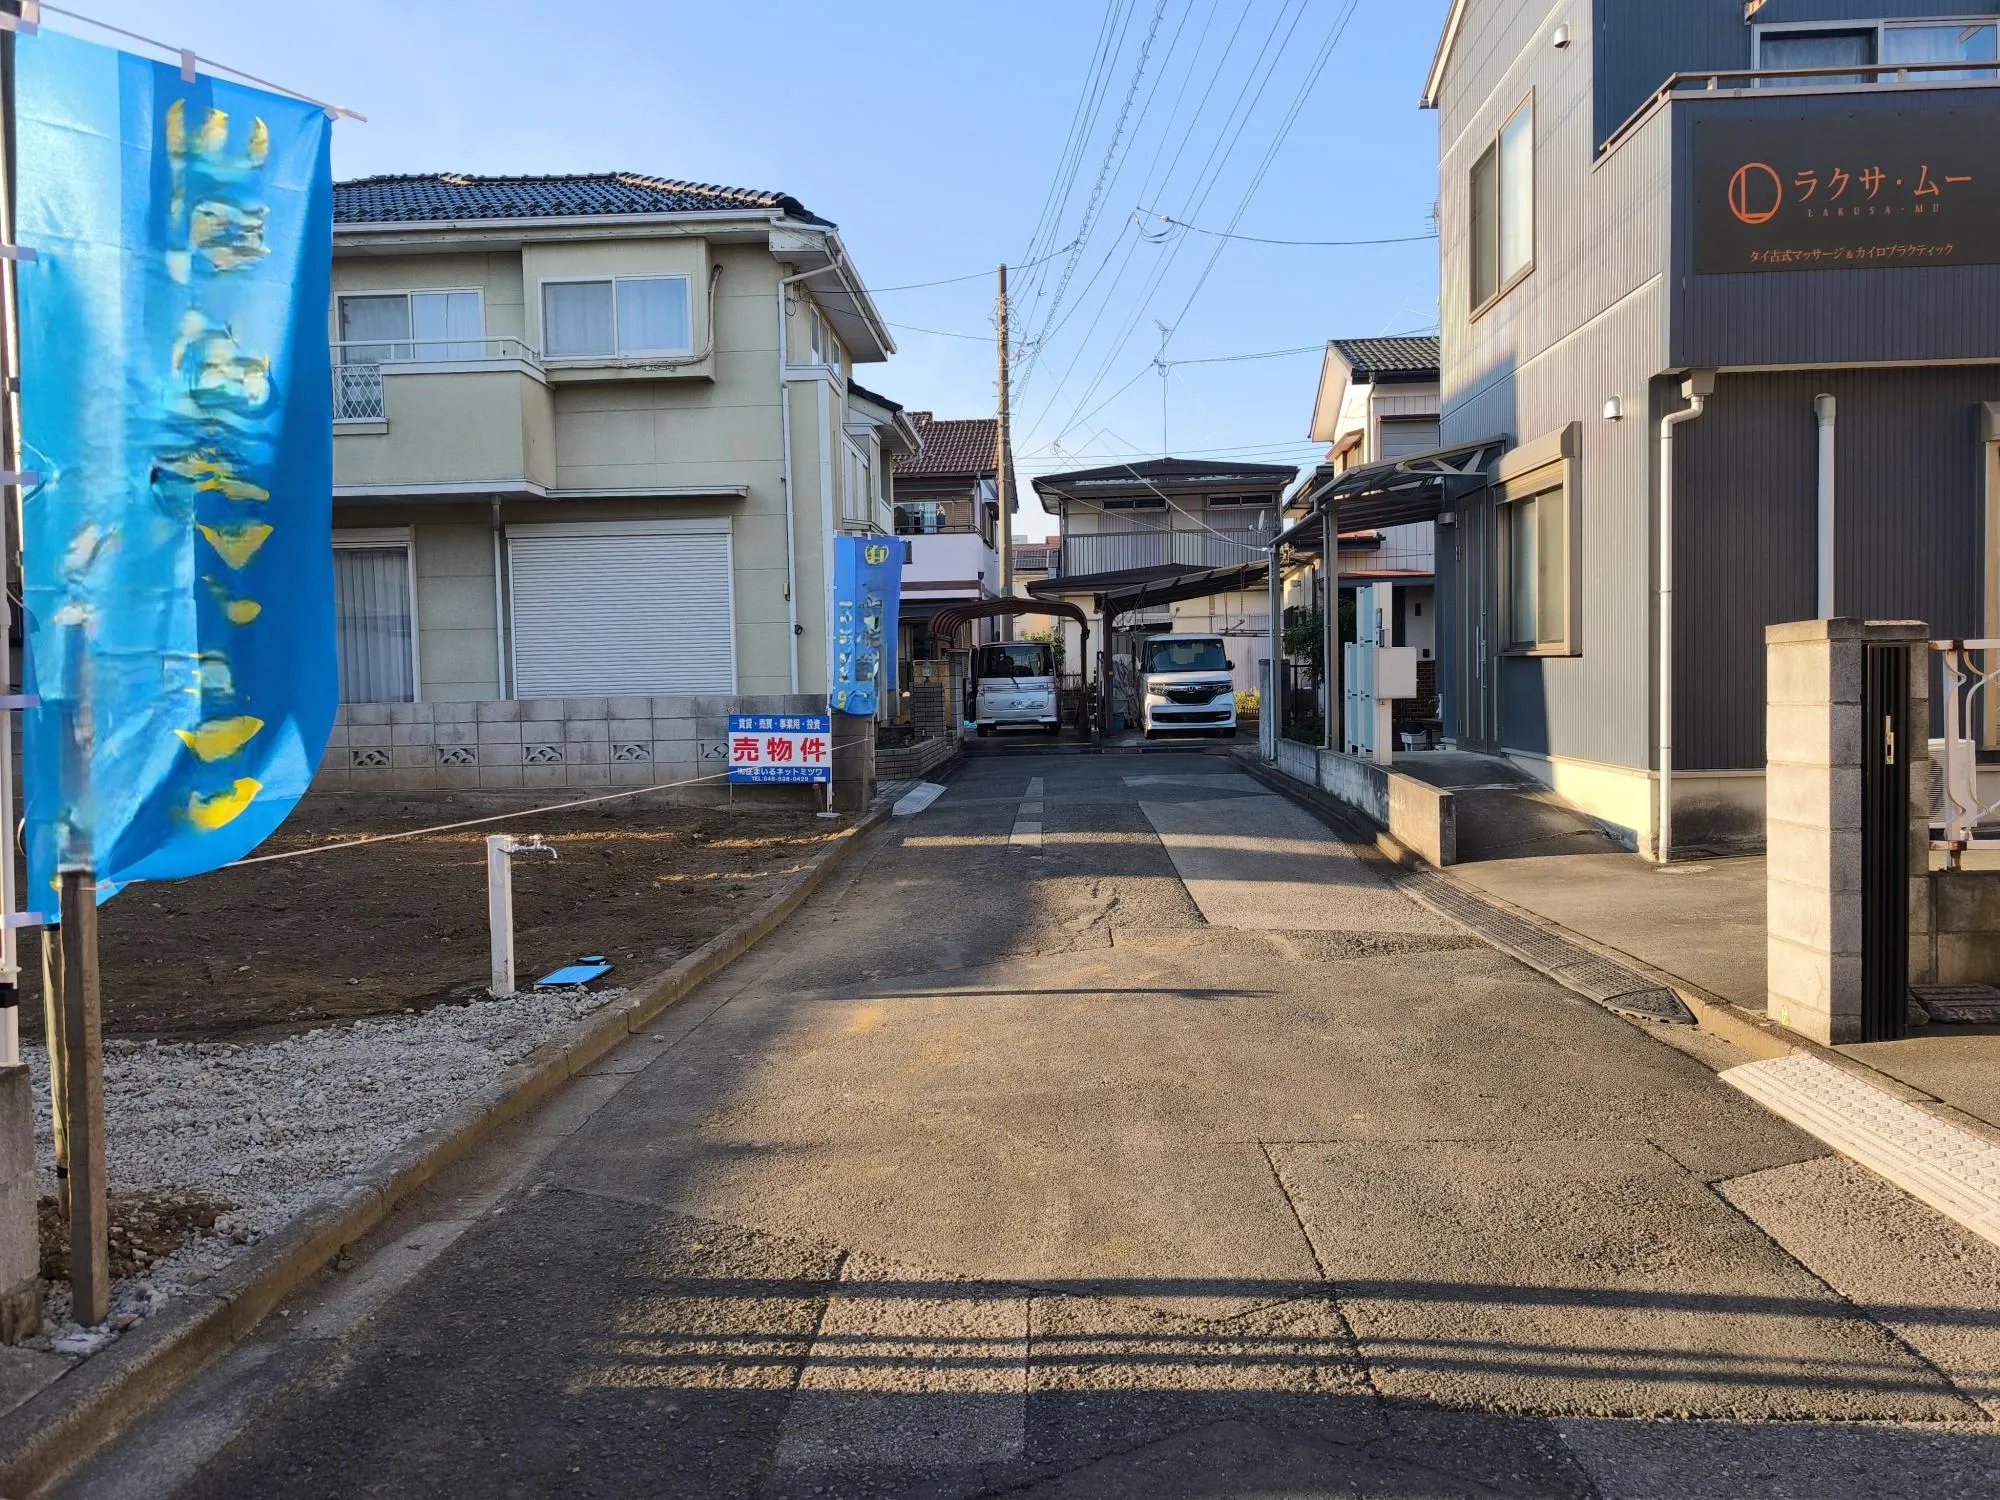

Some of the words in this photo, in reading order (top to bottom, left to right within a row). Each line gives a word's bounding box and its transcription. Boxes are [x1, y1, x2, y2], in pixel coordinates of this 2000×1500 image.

[1794, 164, 1973, 203] ラクサ・ムー
[733, 736, 827, 763] 売物件
